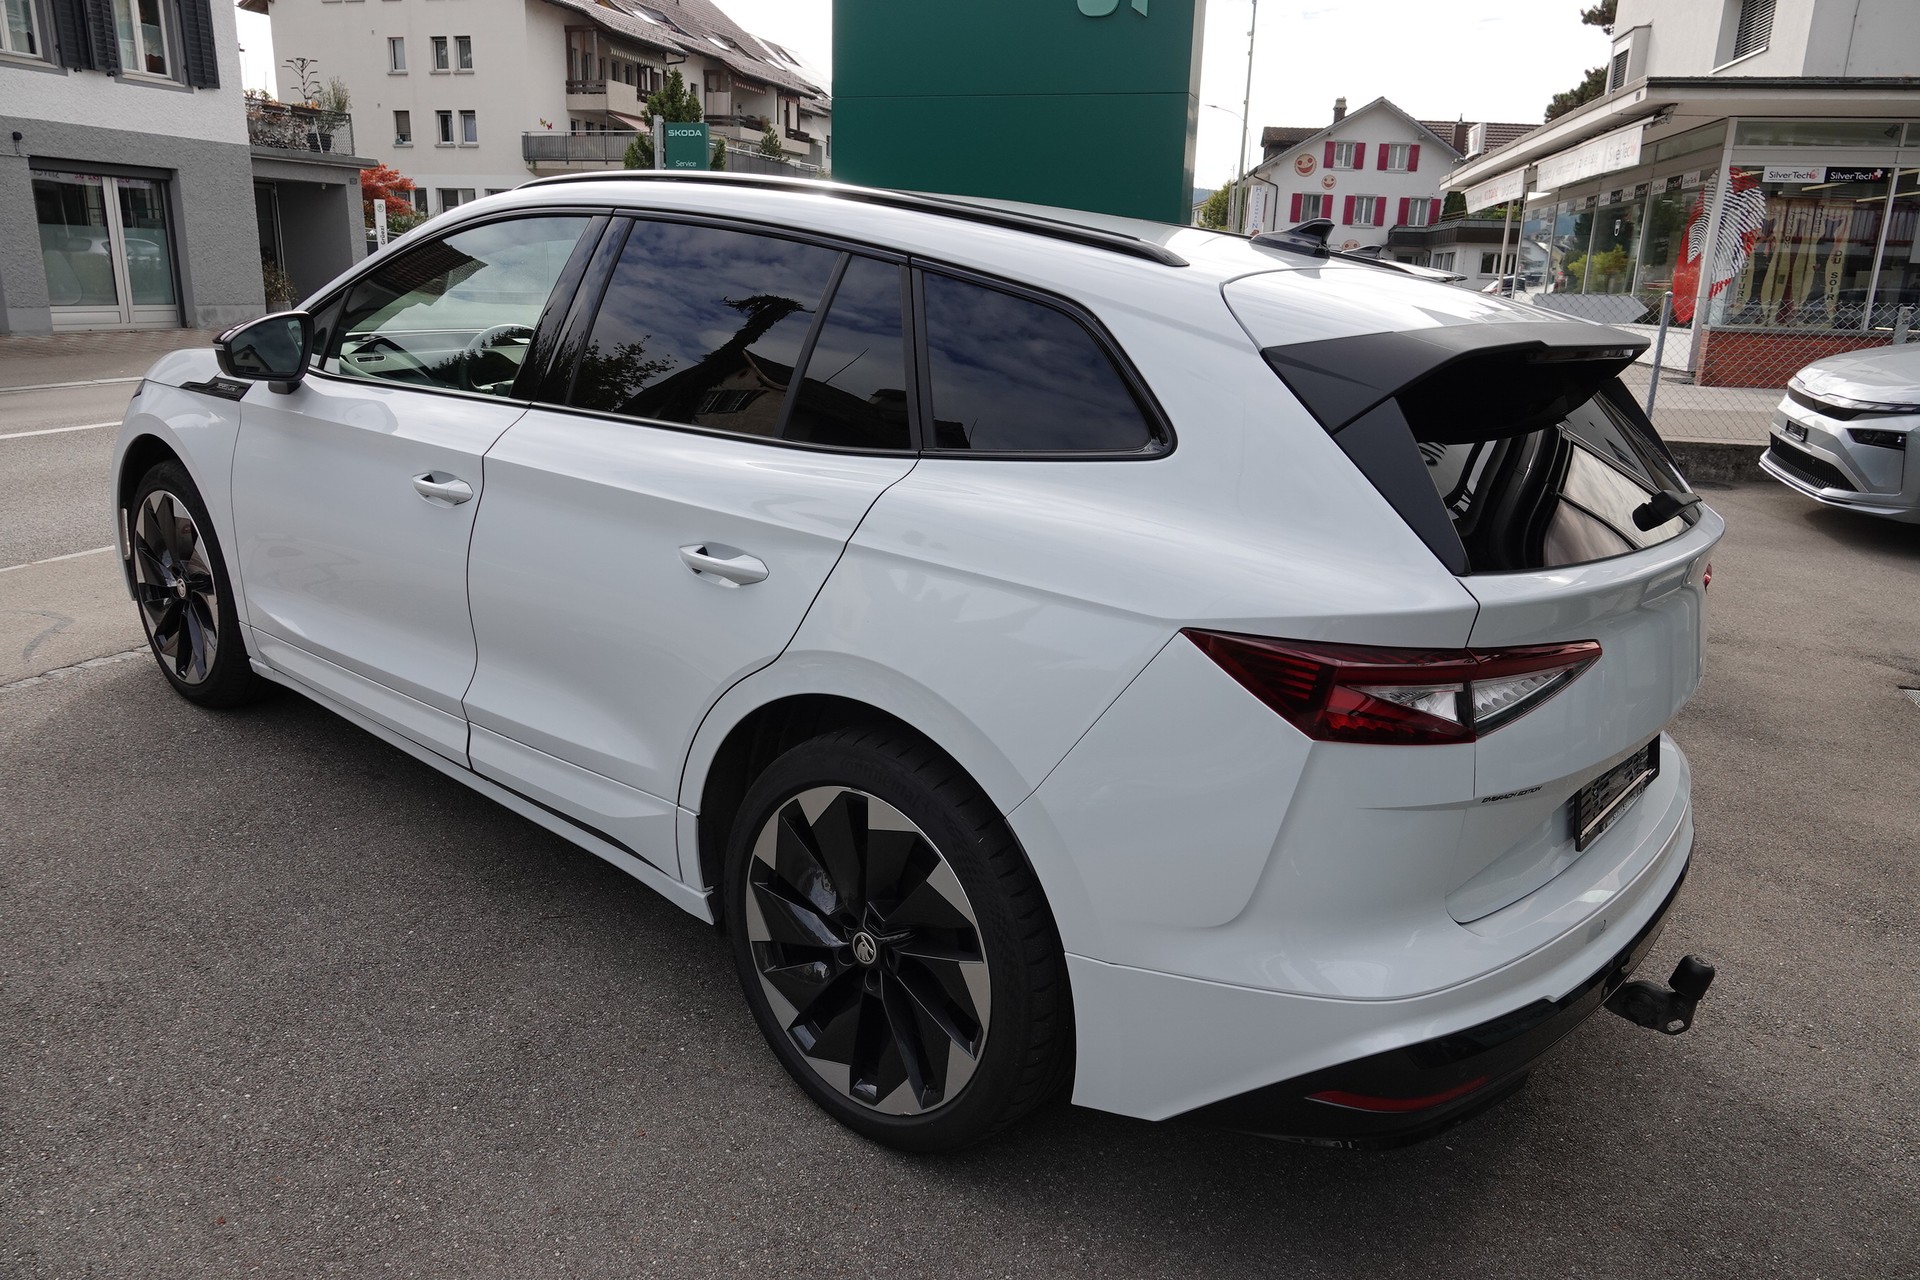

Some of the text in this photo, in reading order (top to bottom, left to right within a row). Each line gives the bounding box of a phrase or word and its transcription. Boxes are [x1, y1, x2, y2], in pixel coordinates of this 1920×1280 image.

[1814, 205, 1825, 234] ROBE
[1826, 250, 1843, 300] DU SOIR
